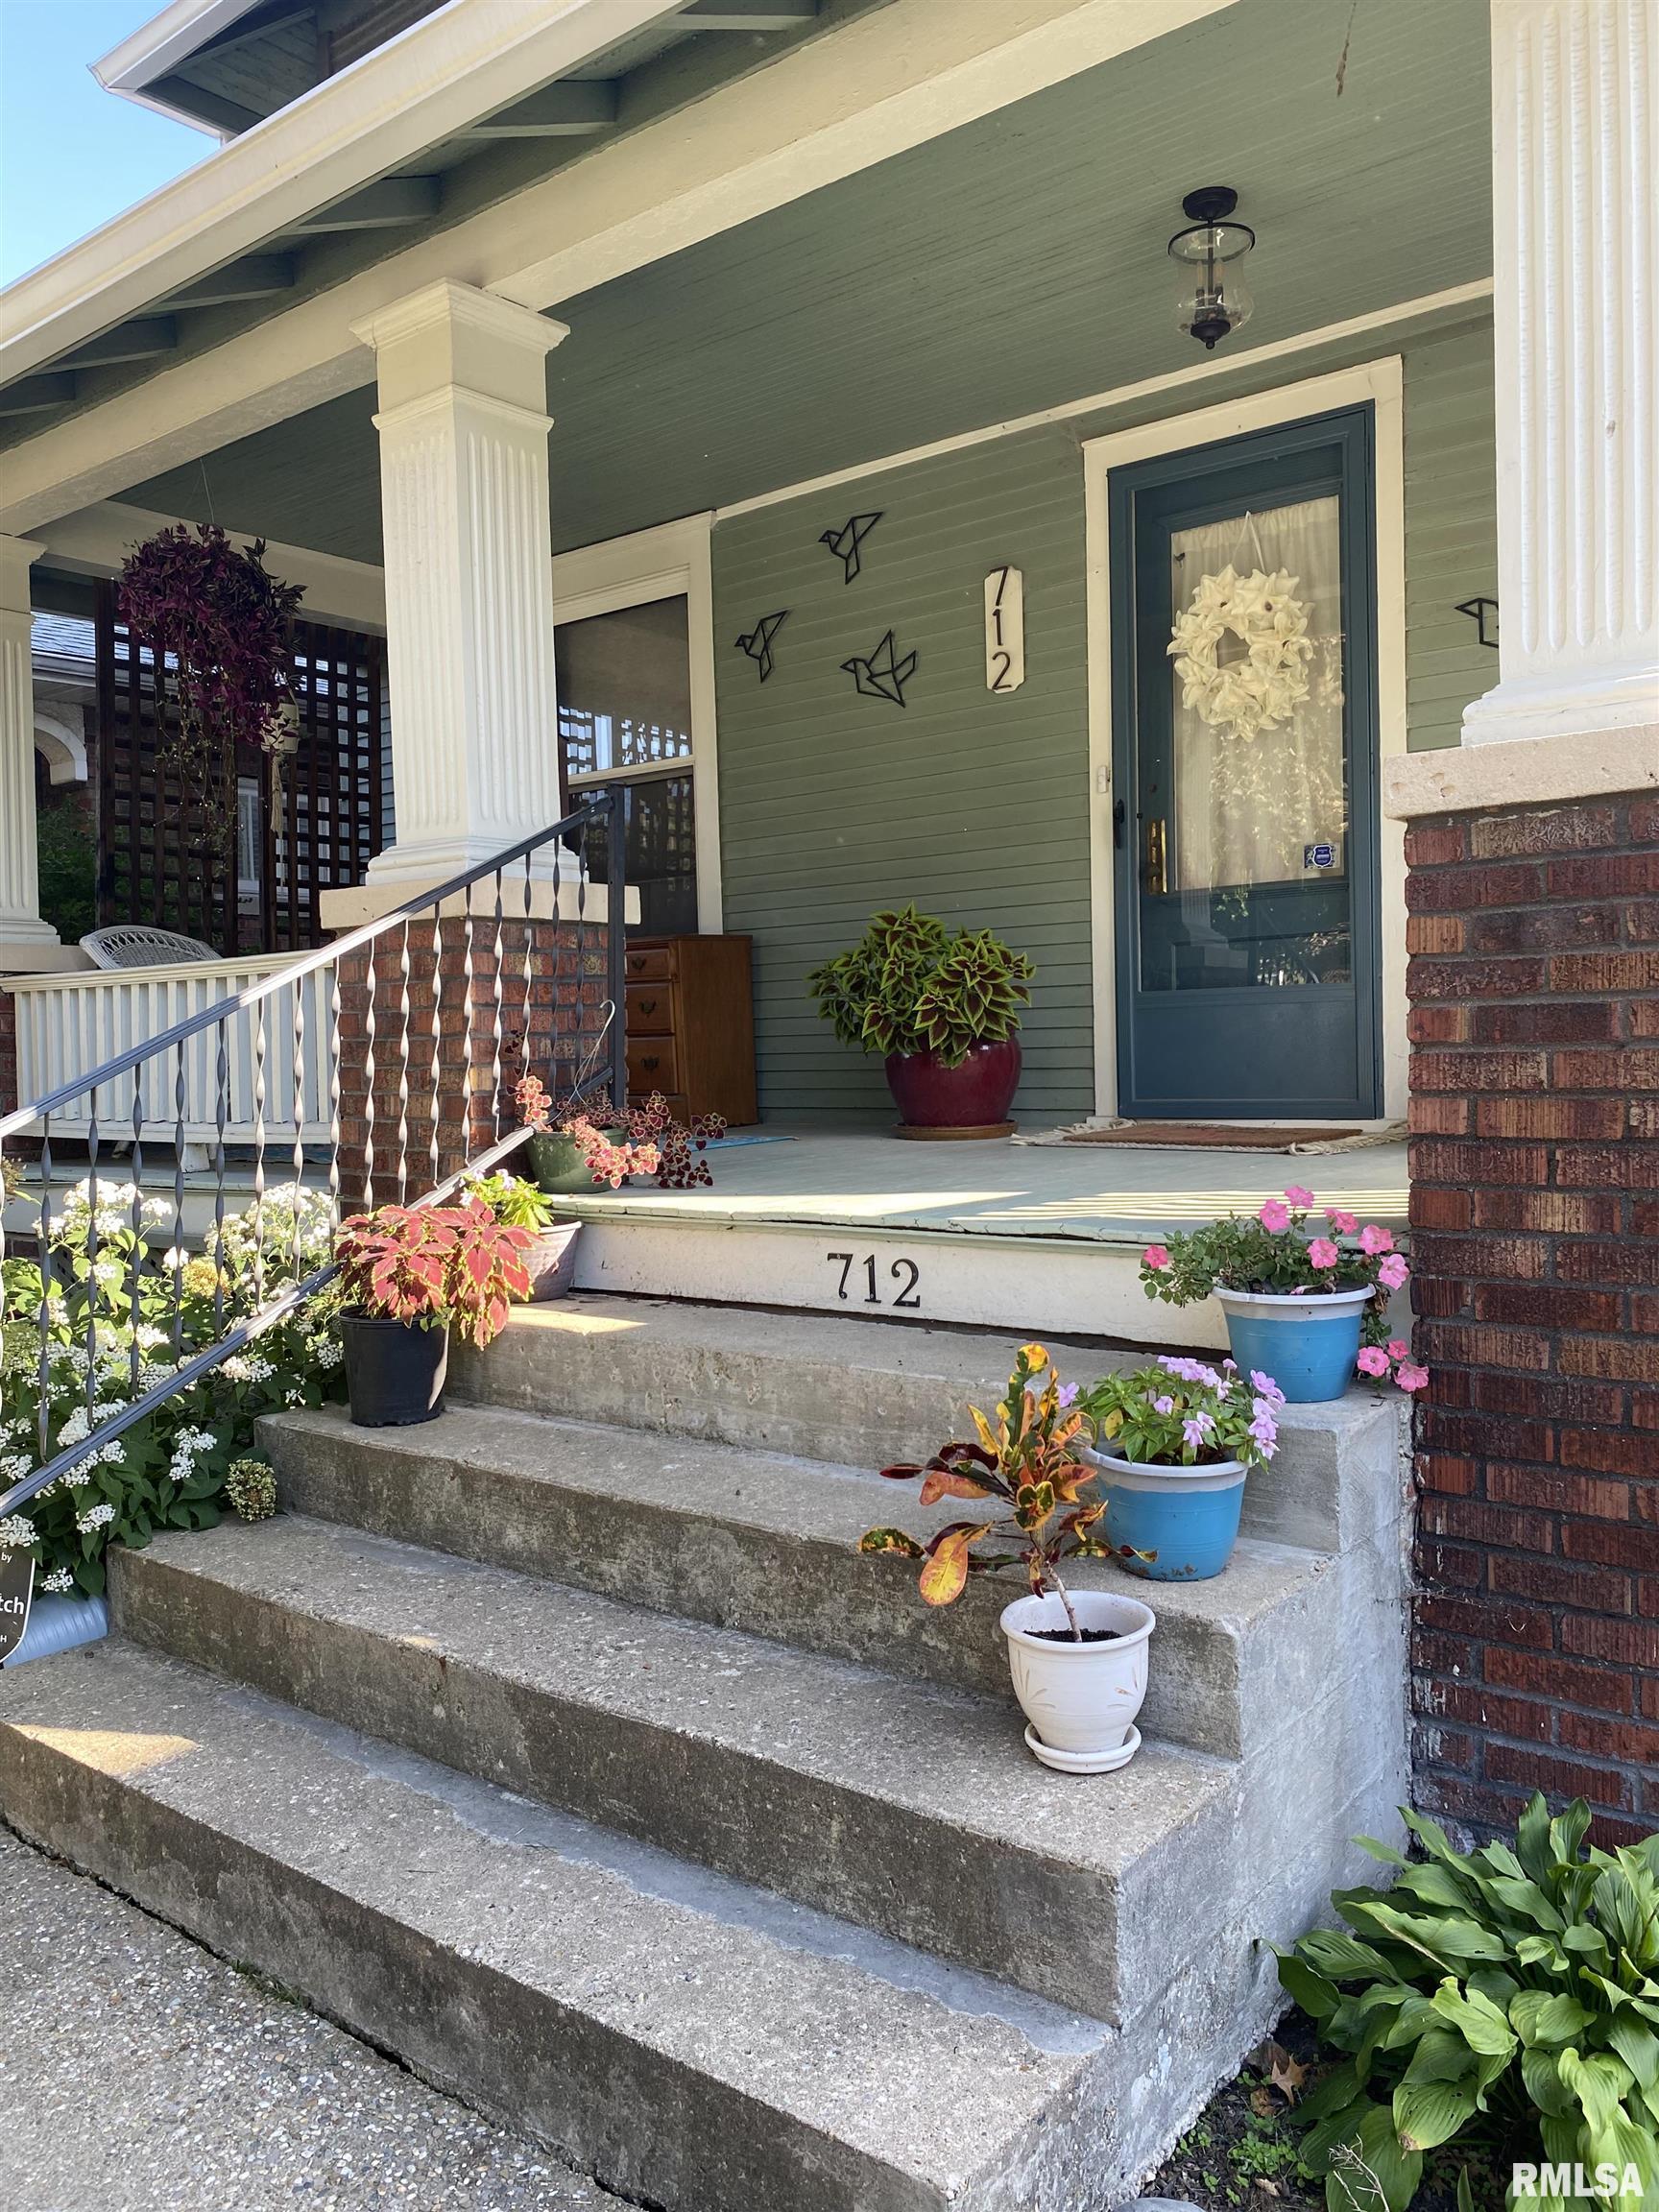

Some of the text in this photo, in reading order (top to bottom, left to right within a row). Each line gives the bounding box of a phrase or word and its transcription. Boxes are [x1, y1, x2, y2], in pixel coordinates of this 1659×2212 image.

[990, 565, 1012, 689] 712
[827, 1253, 921, 1308] 712
[1, 1551, 12, 1564] by
